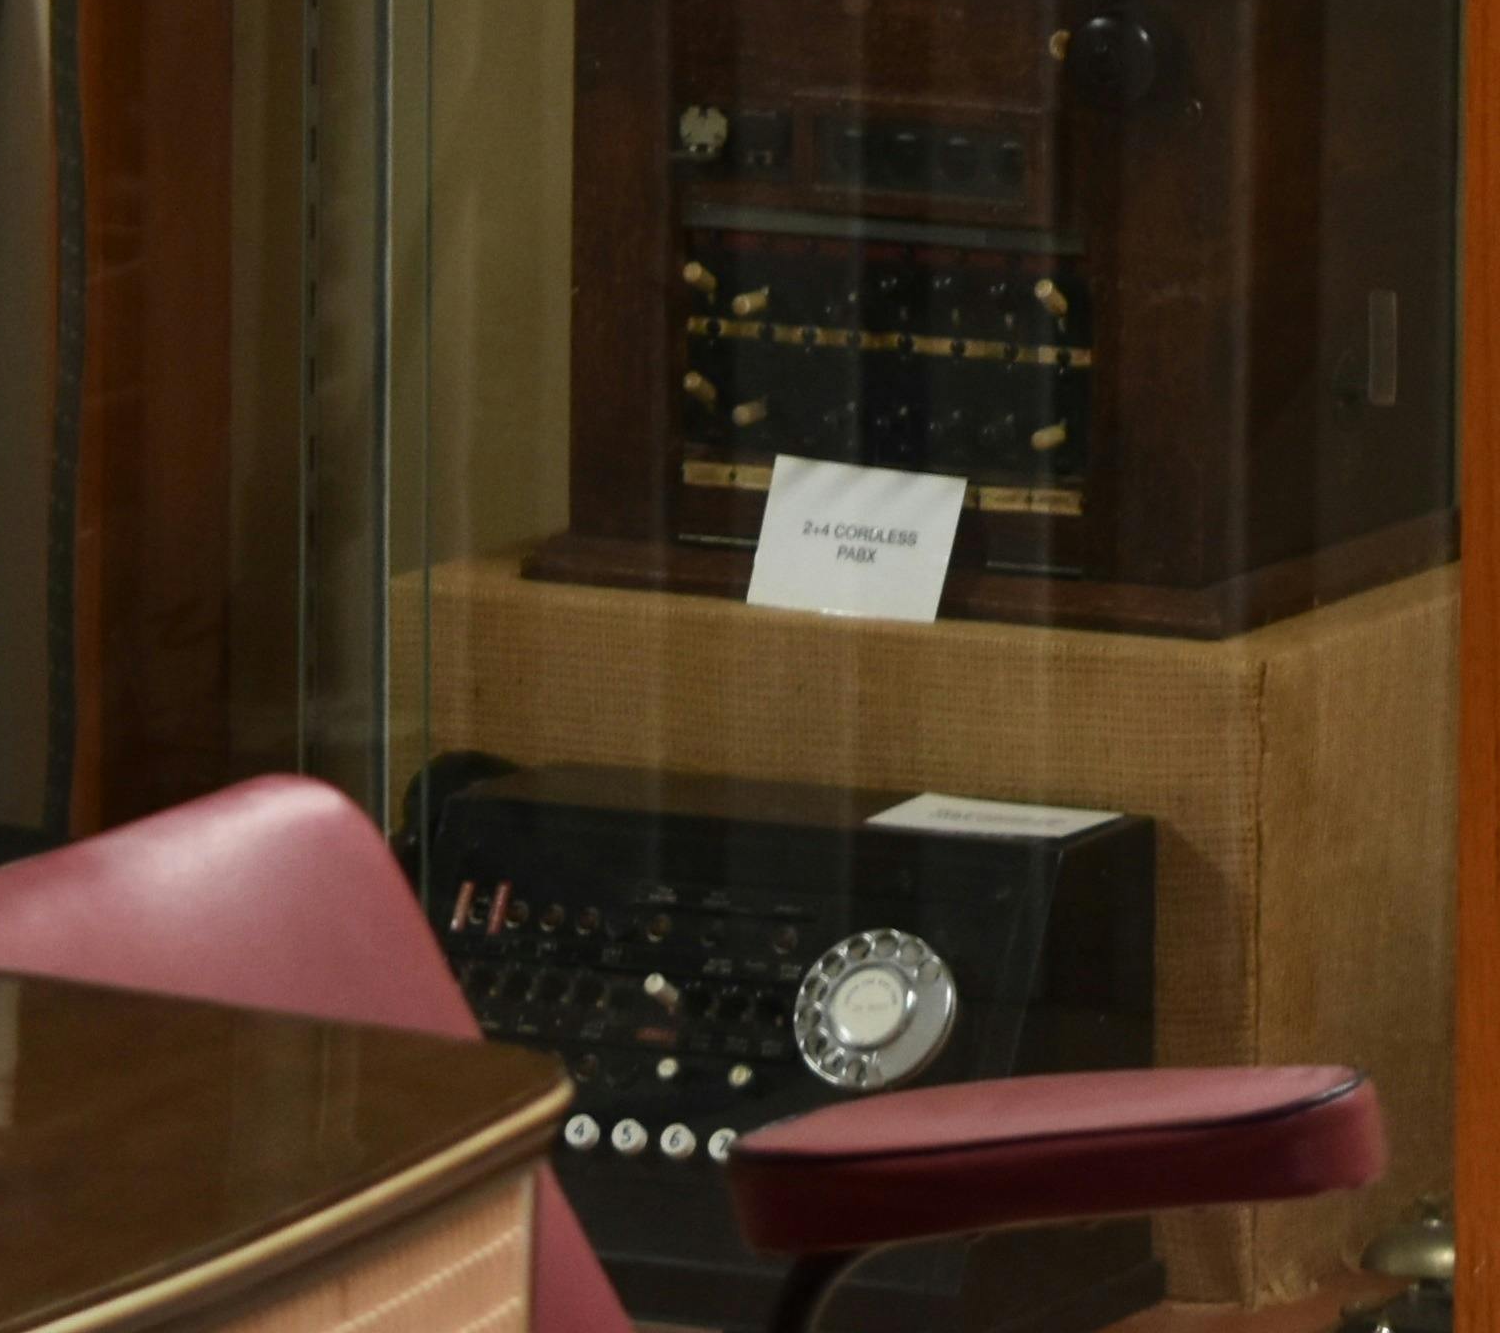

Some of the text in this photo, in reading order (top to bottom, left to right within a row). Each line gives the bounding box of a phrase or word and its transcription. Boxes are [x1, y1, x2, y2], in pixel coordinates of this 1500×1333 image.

[802, 520, 918, 546] 2+4 CORDLESS
[836, 544, 877, 563] PABX
[574, 1123, 585, 1139] 4
[621, 1124, 632, 1142] 5
[669, 1130, 680, 1148] 6
